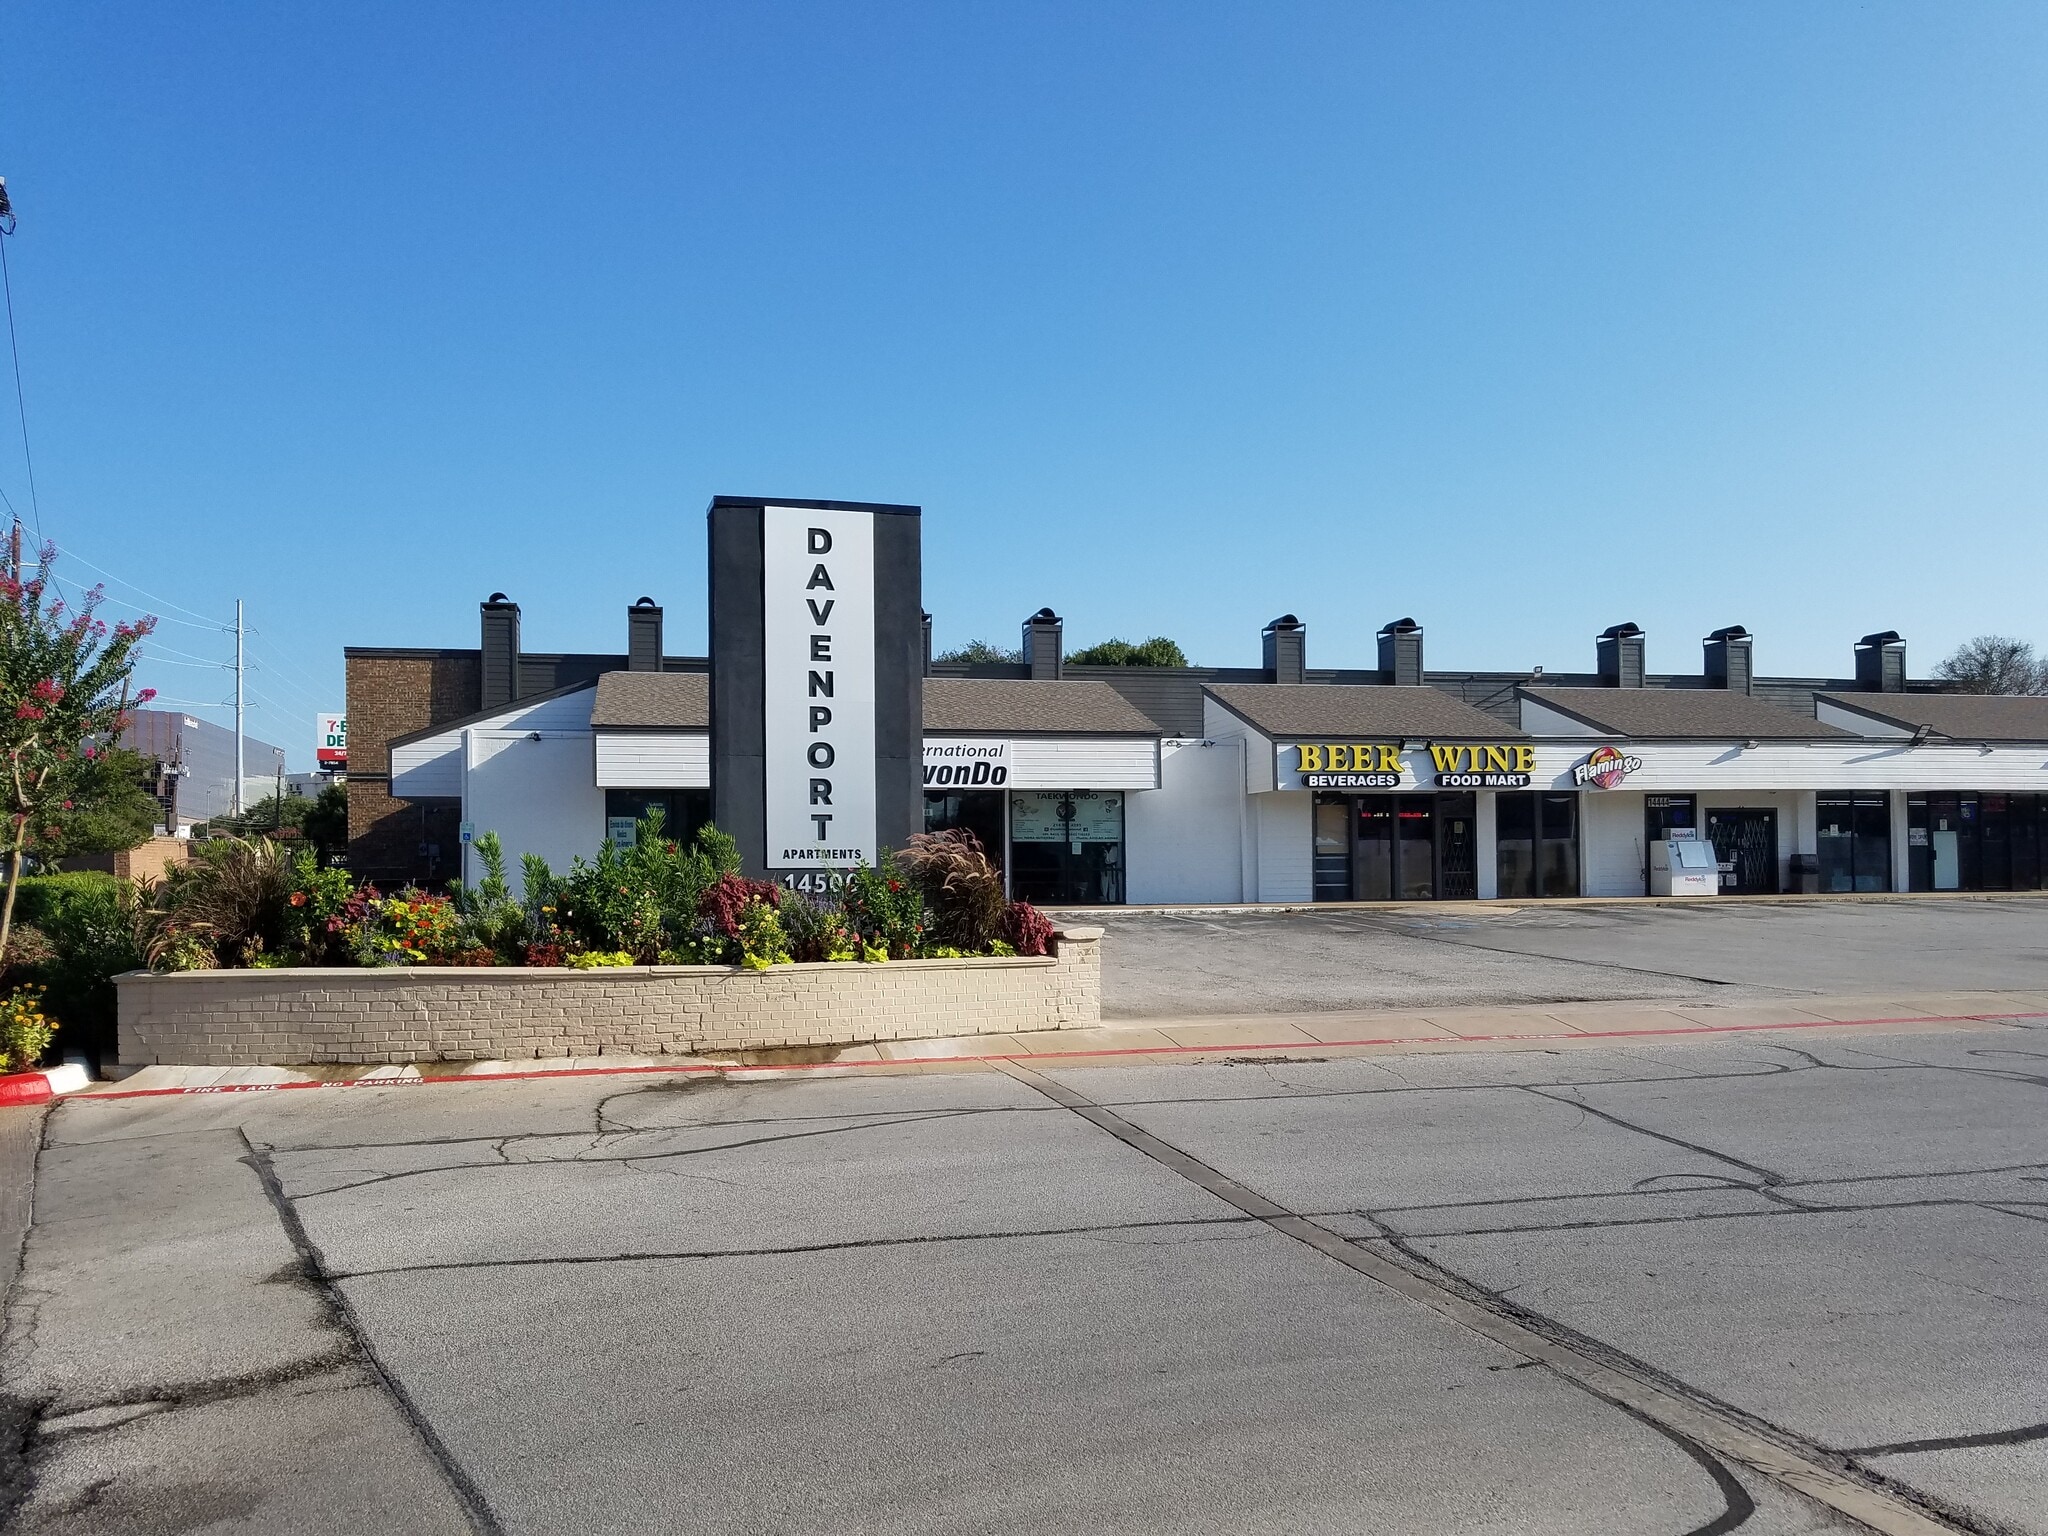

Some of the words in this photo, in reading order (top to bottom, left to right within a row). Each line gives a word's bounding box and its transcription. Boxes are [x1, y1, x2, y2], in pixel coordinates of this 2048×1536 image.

[806, 527, 836, 841] DAVENPORT
[327, 735, 347, 746] DE
[1296, 745, 1405, 772] BEER
[1430, 745, 1537, 773] WINE
[1573, 755, 1643, 786] Flamingo
[1308, 774, 1395, 787] BEVERAGES
[1442, 775, 1483, 787] FOOD
[1485, 775, 1526, 786] MART
[782, 849, 862, 859] APARTMENTS
[353, 1078, 425, 1086] PARKING
